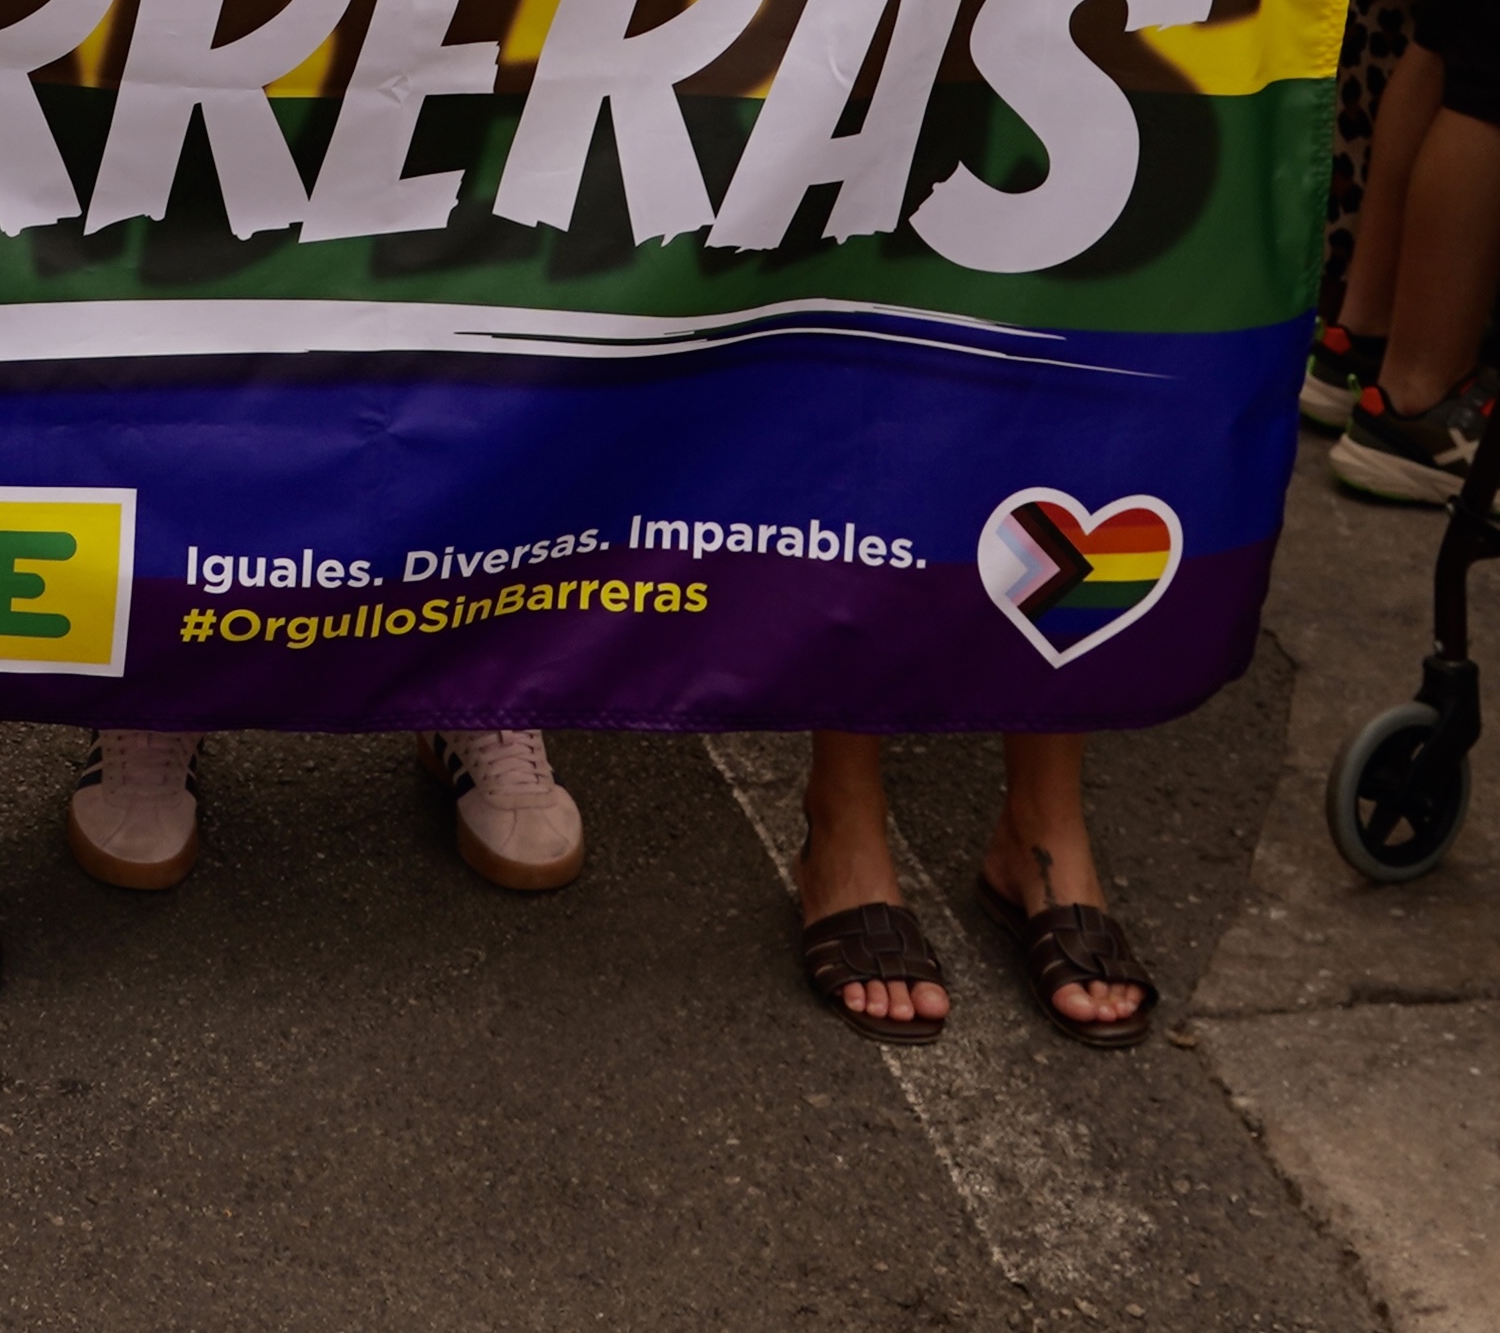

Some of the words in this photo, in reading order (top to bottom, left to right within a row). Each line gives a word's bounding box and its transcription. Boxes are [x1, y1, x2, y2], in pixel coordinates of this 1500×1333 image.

[185, 544, 383, 594] Iguales.
[402, 525, 610, 585] Diversas.
[630, 514, 928, 571] Imparables.
[180, 574, 710, 651] #OrgulloSinBarreras
